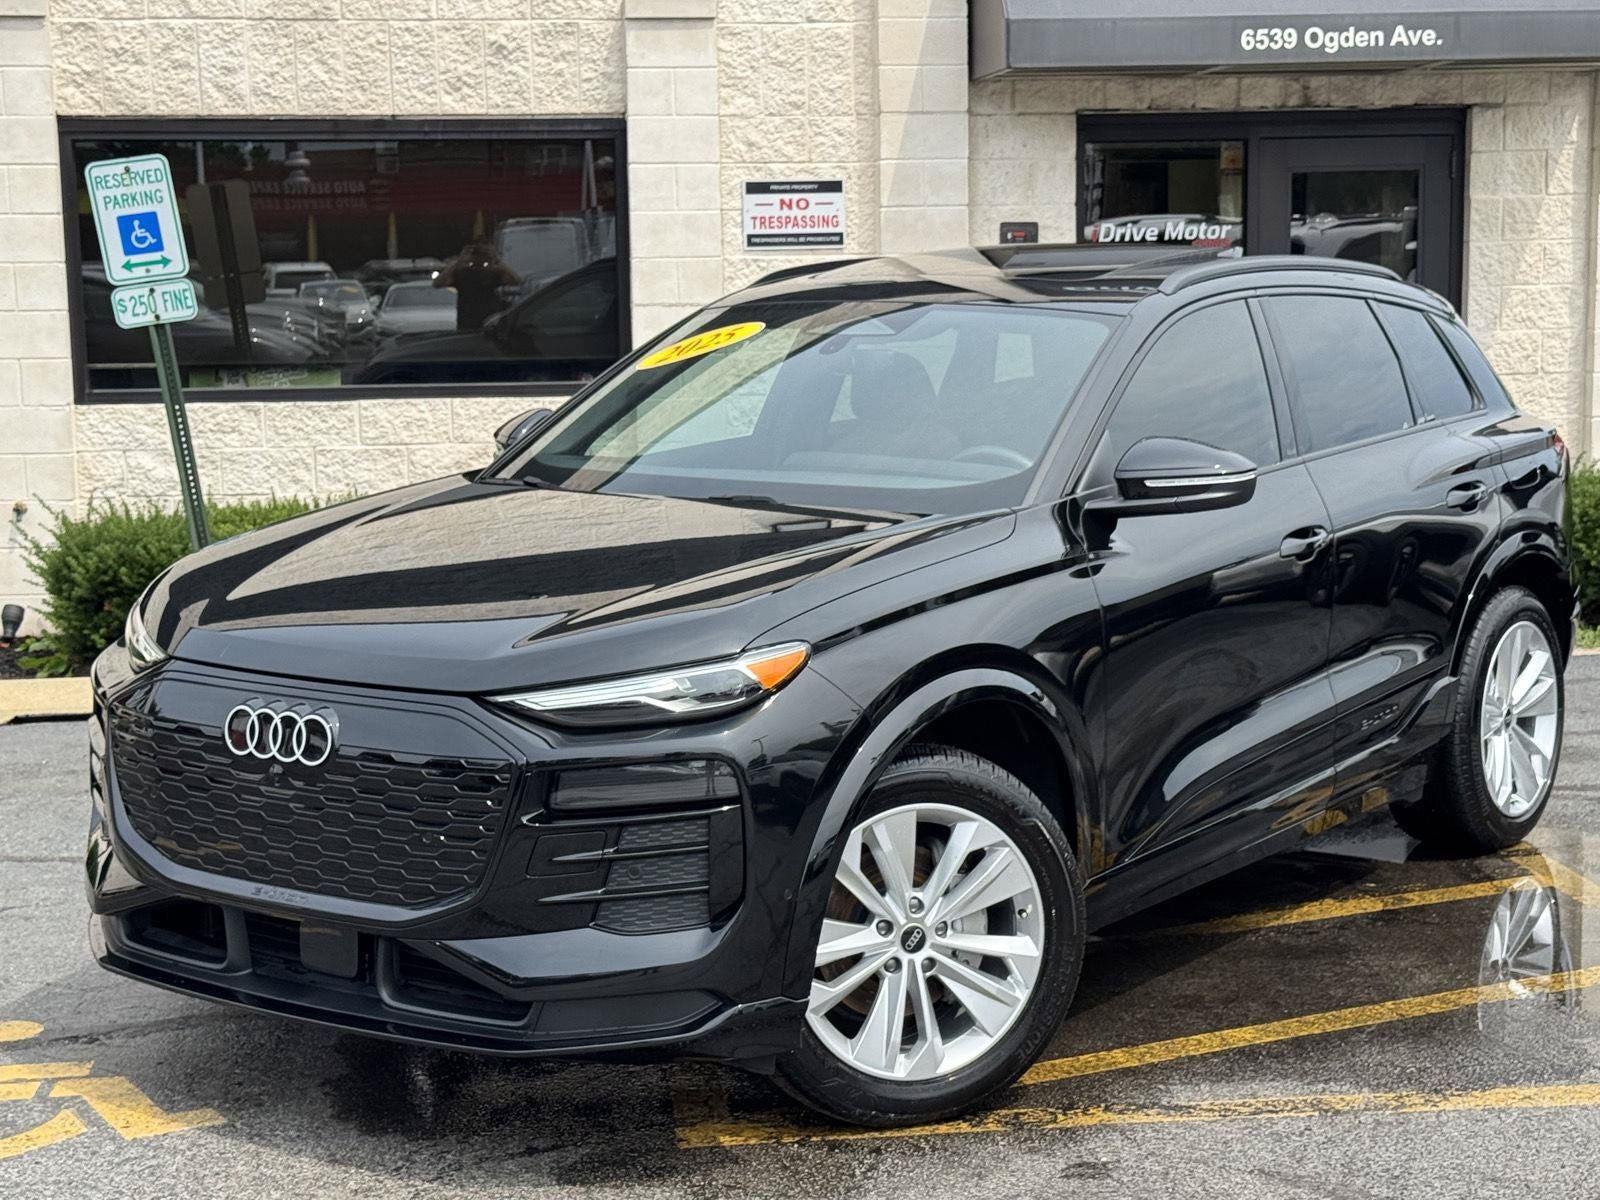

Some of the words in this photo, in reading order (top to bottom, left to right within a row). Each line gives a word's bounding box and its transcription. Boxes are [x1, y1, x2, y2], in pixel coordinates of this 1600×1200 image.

[1240, 28, 1298, 51] 6539
[1304, 26, 1385, 54] Ogden
[1389, 24, 1444, 47] Ave.
[94, 167, 164, 191] RESERVED
[103, 188, 164, 211] PARKING
[779, 197, 810, 210] NO
[751, 214, 840, 230] TRESPASSING
[1091, 222, 1158, 243] iDrive
[1164, 221, 1232, 241] Motor
[161, 288, 193, 313] FINE
